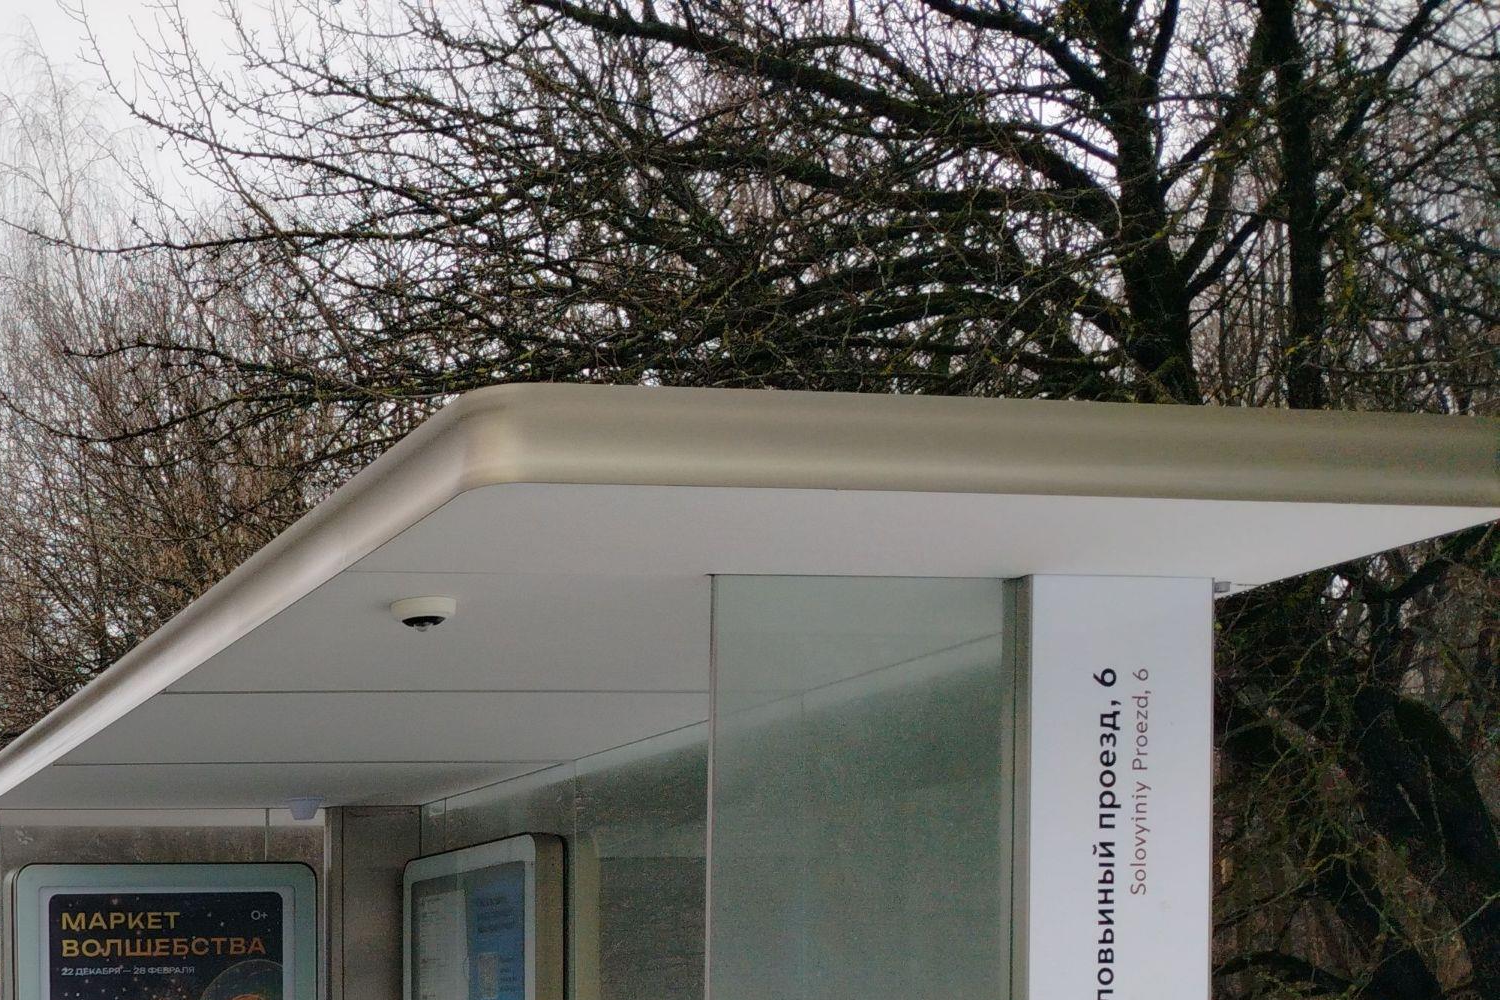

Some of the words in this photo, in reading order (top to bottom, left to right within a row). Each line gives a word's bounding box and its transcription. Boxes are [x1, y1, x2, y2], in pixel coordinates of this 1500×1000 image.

[1093, 668, 1117, 687] 6
[1132, 668, 1149, 681] 6
[1132, 690, 1152, 771] Proezd,
[1099, 700, 1121, 829] проезд,
[1130, 780, 1152, 895] Solovyiniy
[61, 911, 180, 930] МАРКЕТ
[251, 910, 268, 921] 0+
[61, 937, 266, 958] ВОЛШЕБСТВА
[61, 967, 74, 976] 22
[75, 967, 120, 977] ДЕКАБРЯ
[133, 966, 146, 975] 28
[147, 966, 195, 975] ФЕВРАЛЯ
